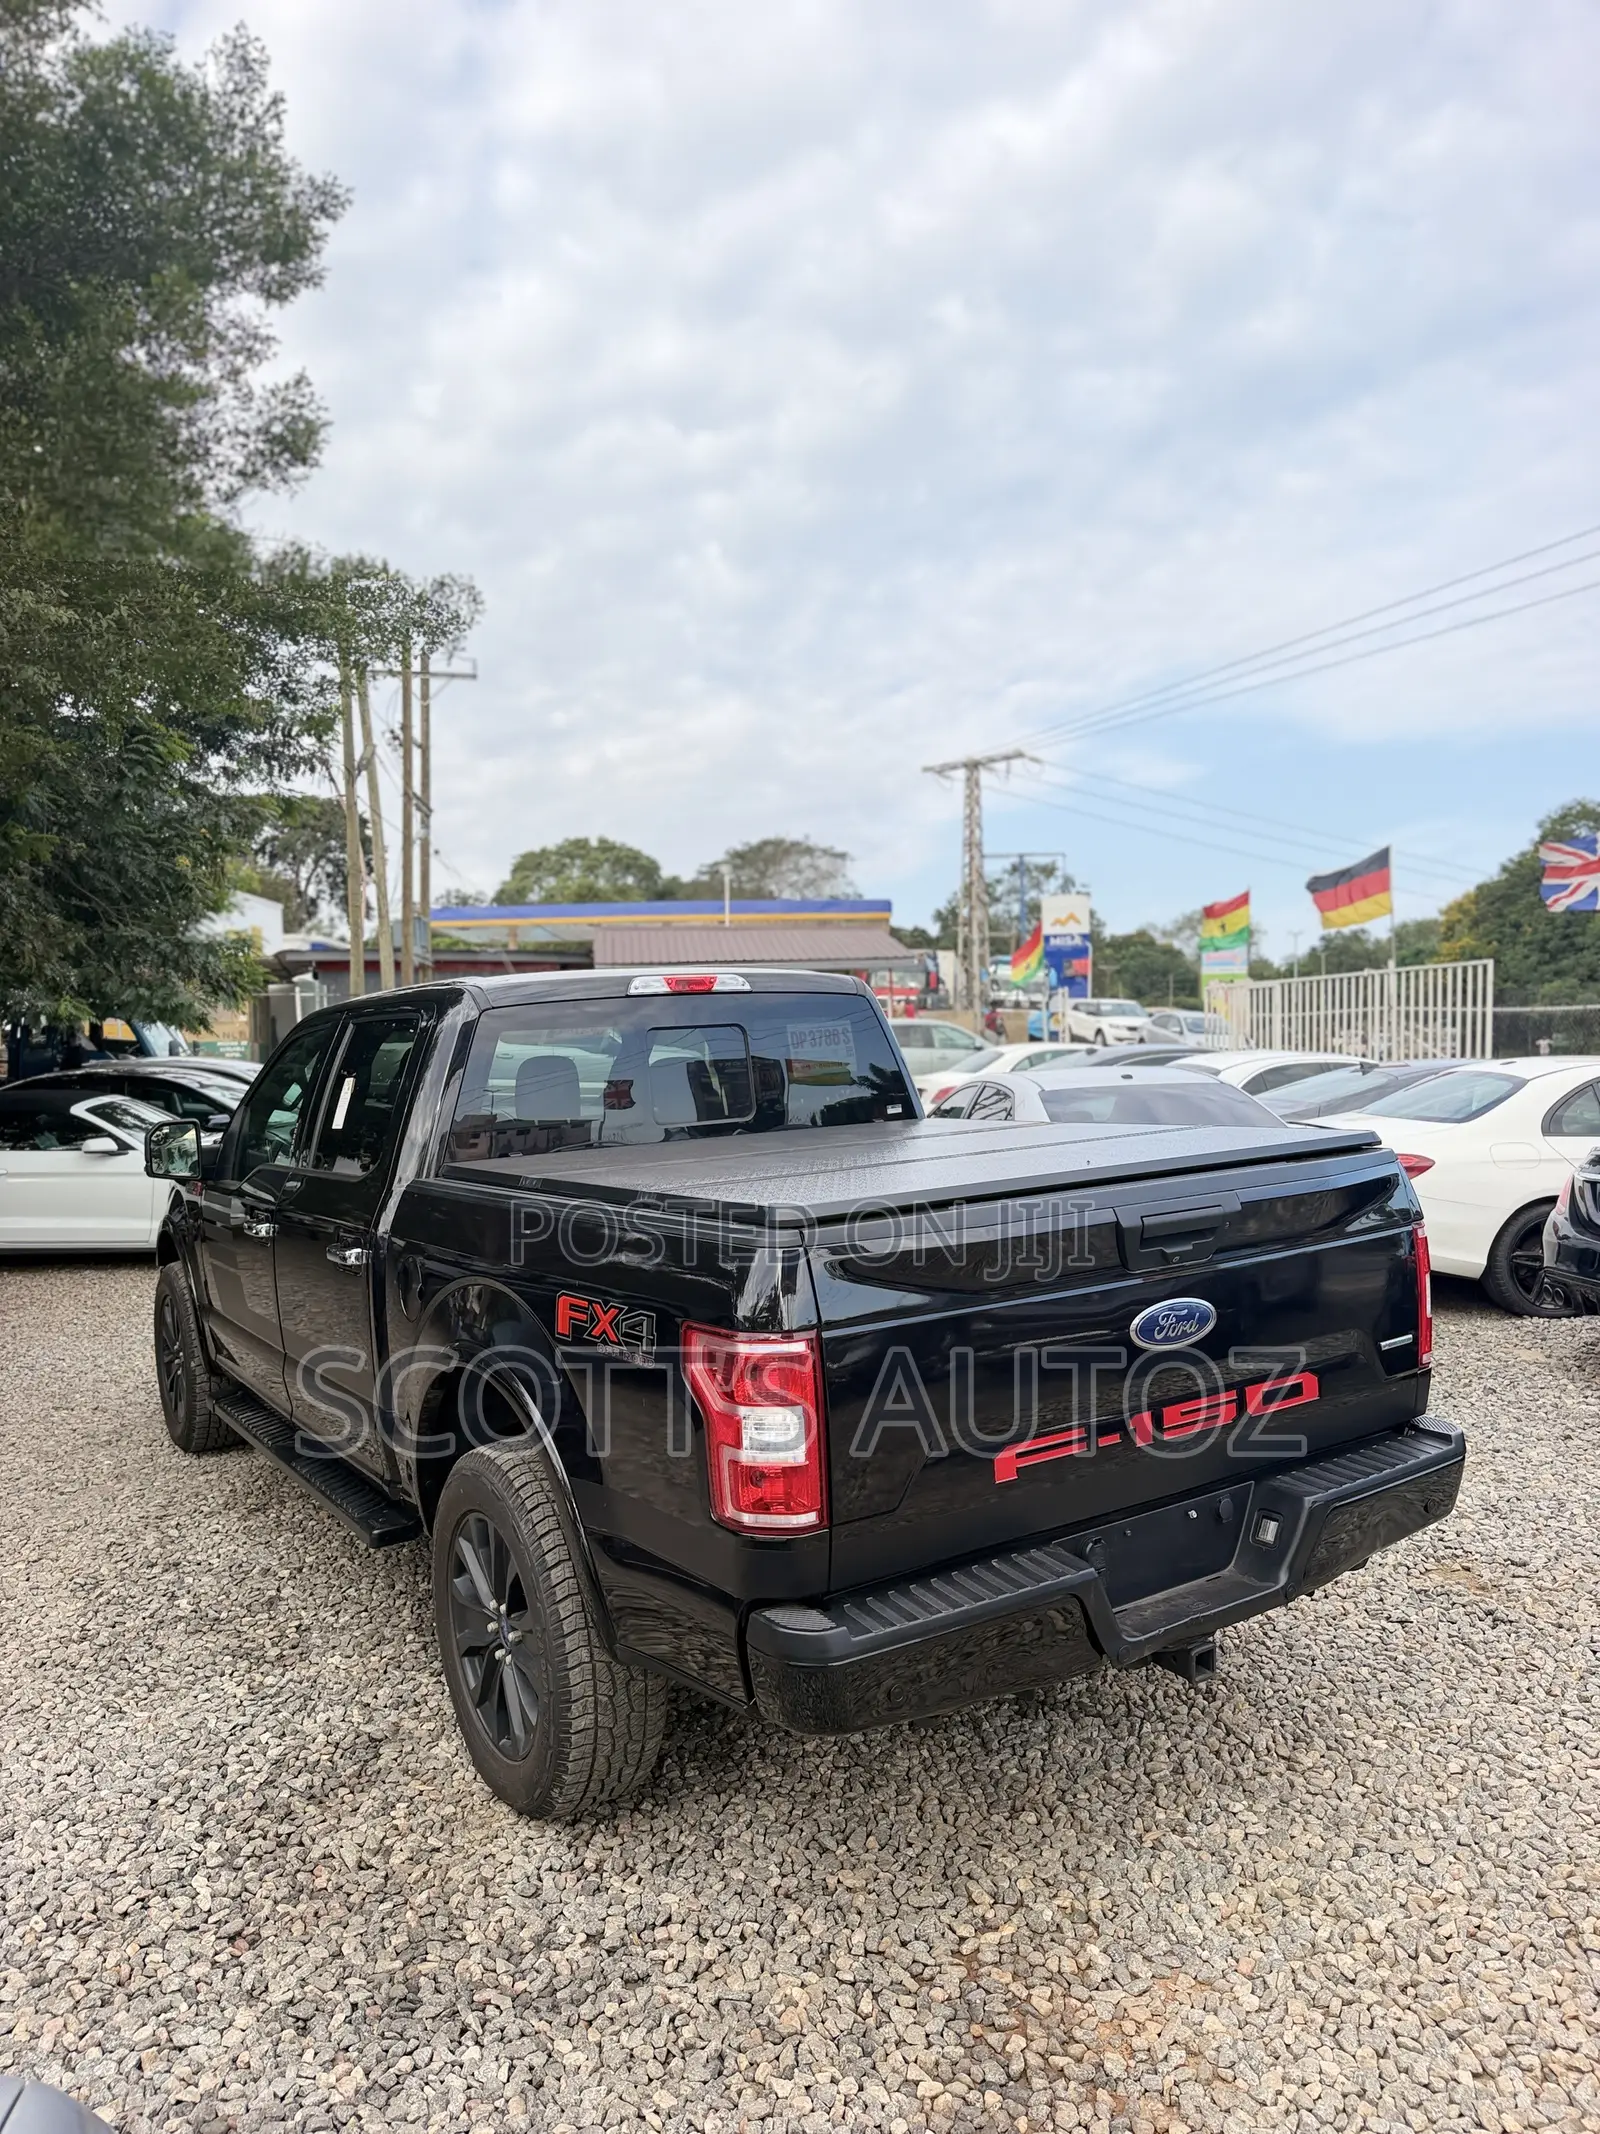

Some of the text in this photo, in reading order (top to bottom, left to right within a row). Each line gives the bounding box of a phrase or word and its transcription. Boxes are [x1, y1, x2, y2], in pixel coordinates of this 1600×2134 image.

[556, 1290, 656, 1358] FX4
[1154, 1308, 1200, 1340] Ford
[622, 1350, 656, 1369] ROAD
[993, 1371, 1320, 1484] F-150
